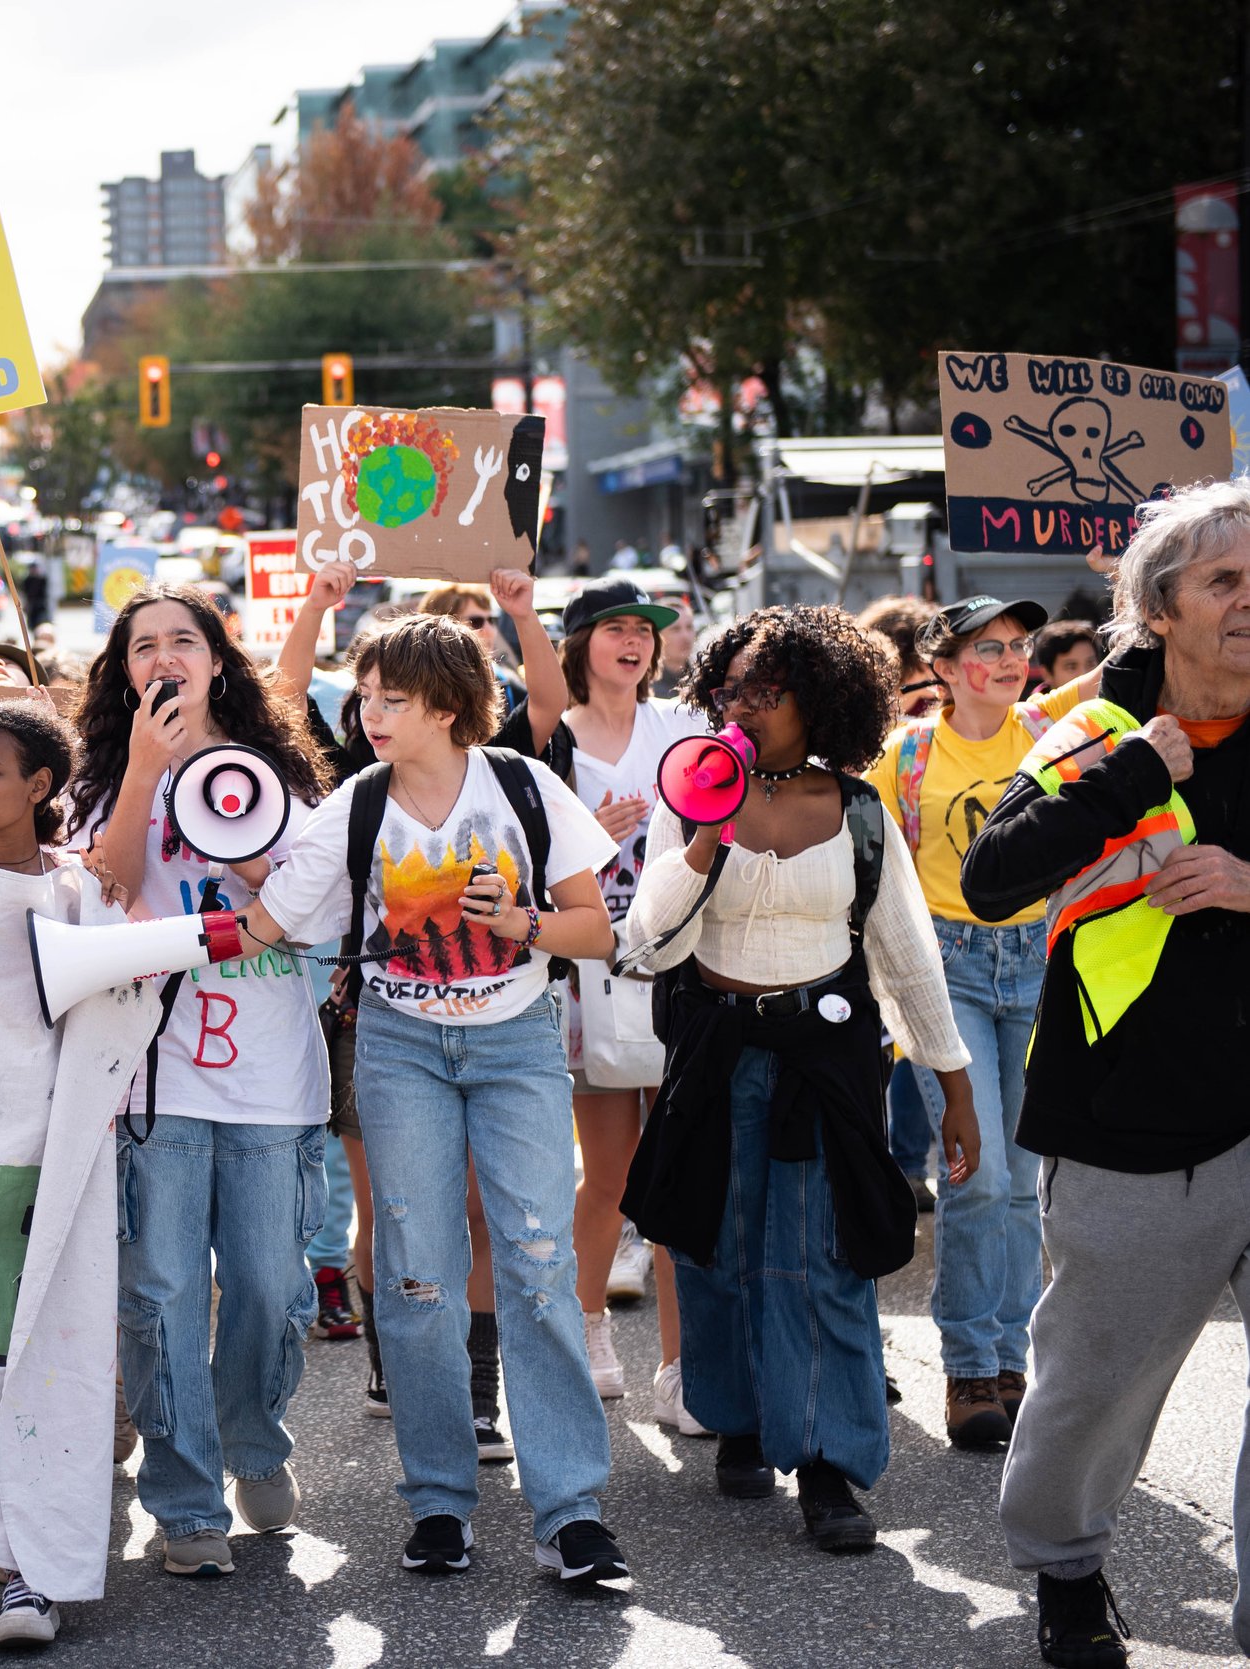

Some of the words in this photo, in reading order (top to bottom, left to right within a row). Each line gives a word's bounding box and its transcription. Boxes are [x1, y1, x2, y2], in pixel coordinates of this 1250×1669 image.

[946, 354, 1008, 393] WE
[1028, 359, 1093, 395] WILL
[1101, 364, 1131, 396] BE
[1139, 374, 1176, 401] OUR
[1180, 382, 1225, 413] OWN
[302, 529, 376, 572] GO
[193, 990, 238, 1069] B
